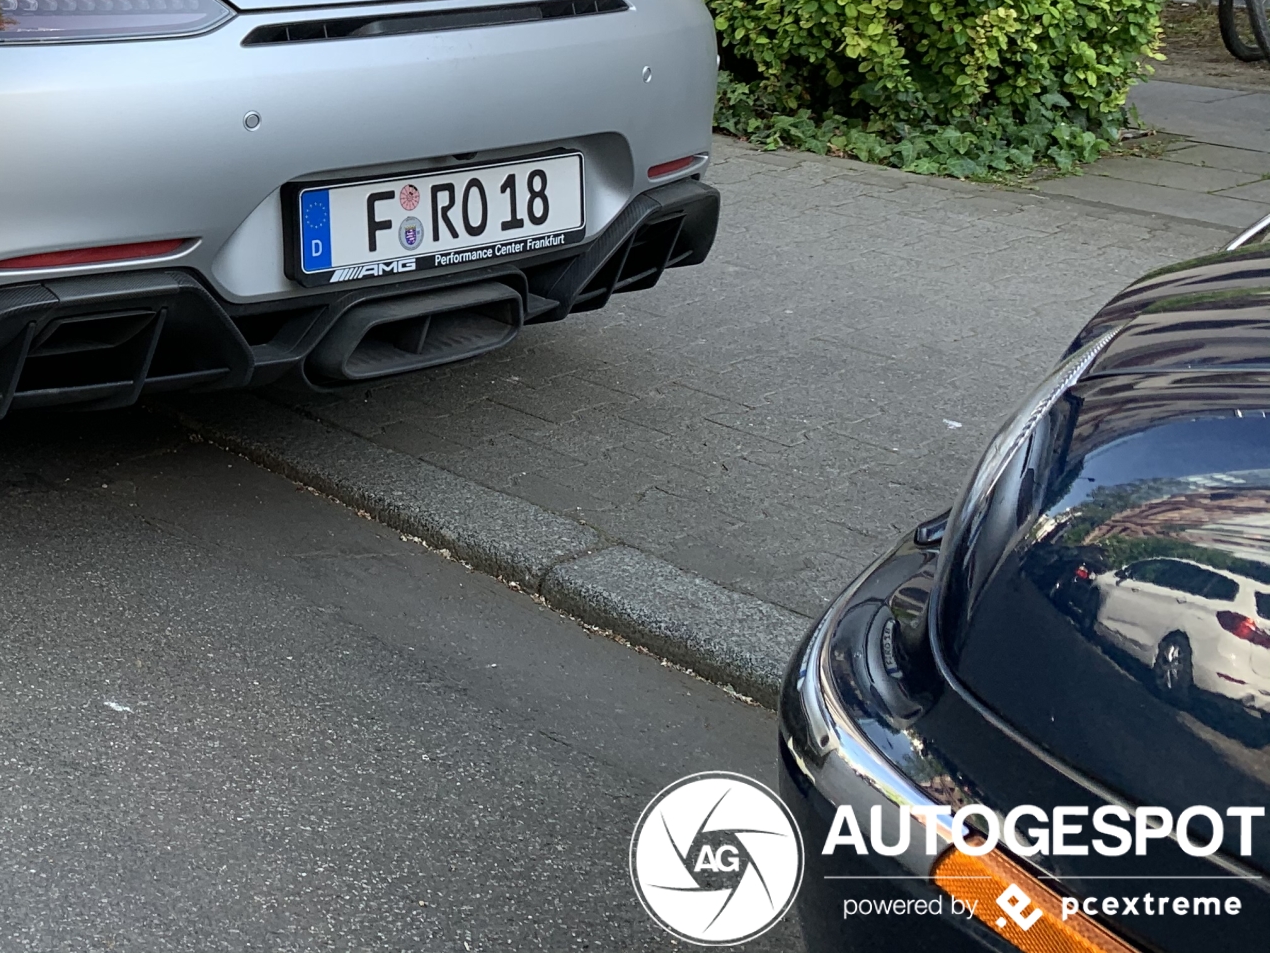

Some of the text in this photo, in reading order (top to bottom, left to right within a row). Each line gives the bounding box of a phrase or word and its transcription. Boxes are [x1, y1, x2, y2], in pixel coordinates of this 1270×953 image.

[366, 169, 550, 252] F RO 18
[311, 239, 323, 258] D
[434, 248, 493, 267] Performance
[494, 242, 525, 258] Center
[526, 233, 566, 251] Frankfurt
